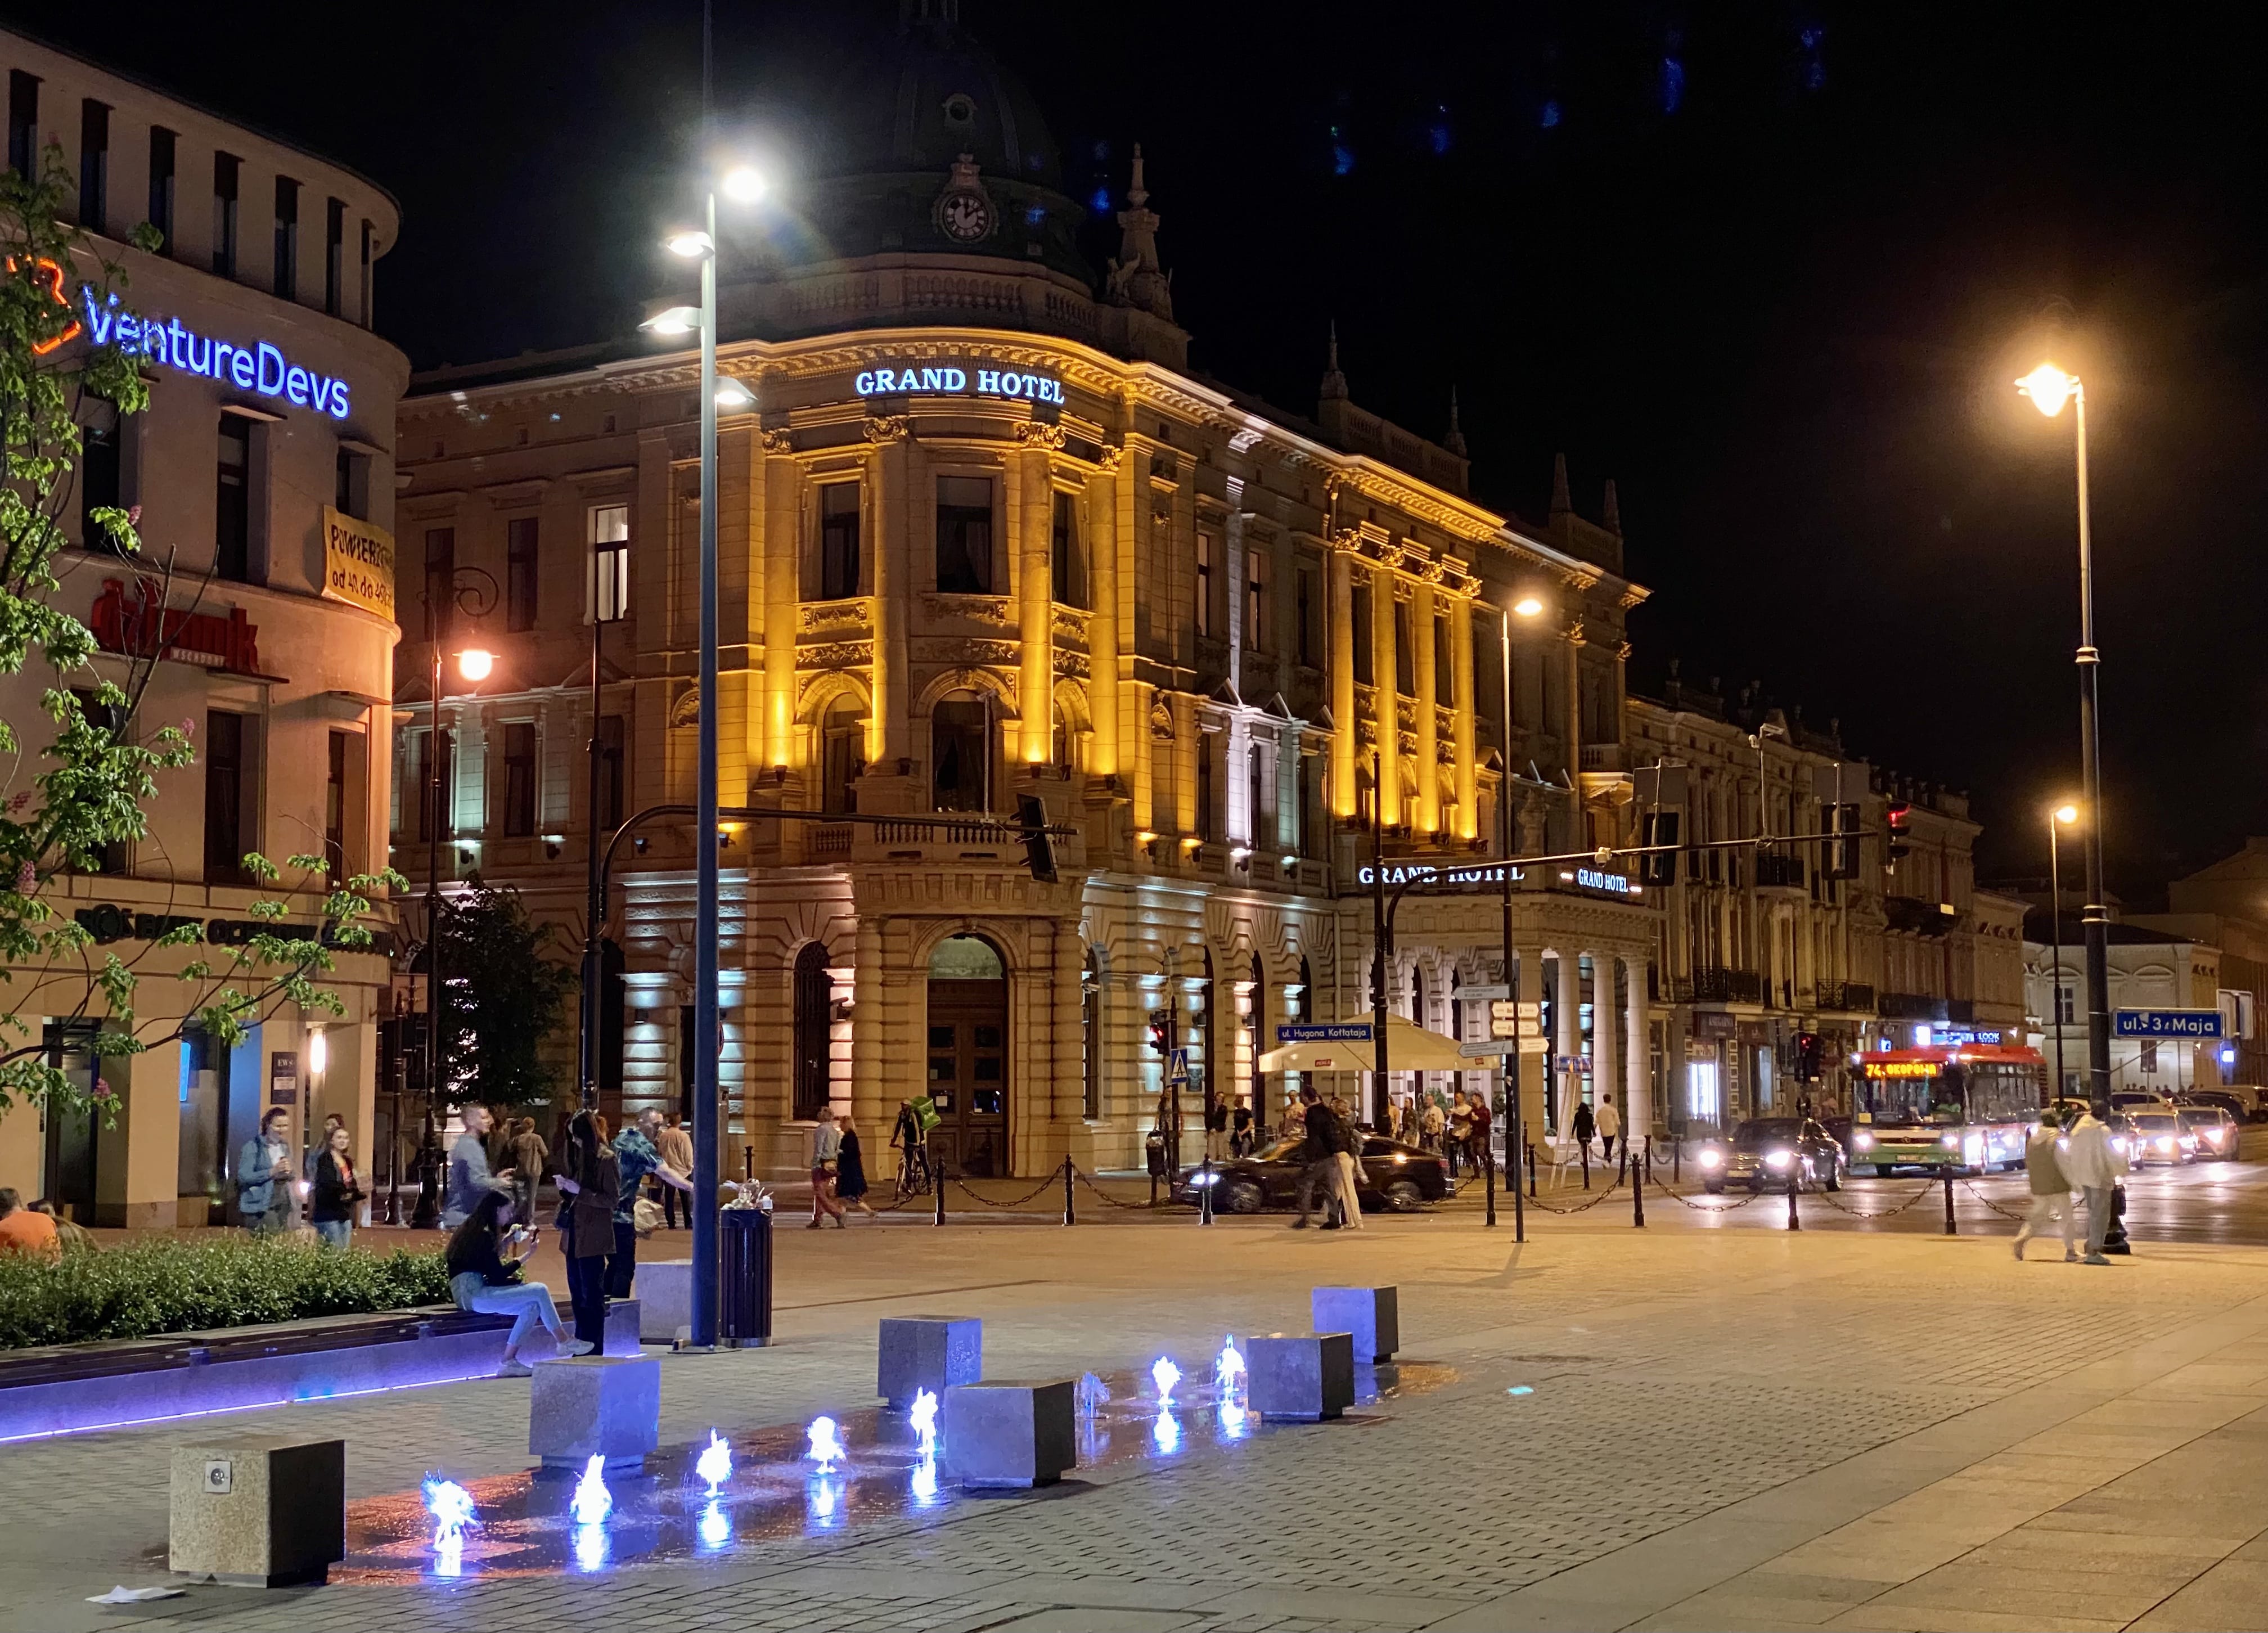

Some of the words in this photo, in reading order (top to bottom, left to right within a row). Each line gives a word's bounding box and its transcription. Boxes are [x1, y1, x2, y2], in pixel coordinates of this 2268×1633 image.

[83, 285, 349, 419] VentureDevs
[856, 368, 966, 394] GRAND
[978, 370, 1065, 404] HOTEL
[332, 568, 345, 589] od
[1358, 866, 1438, 884] GRAND
[1578, 868, 1604, 889] GRAND
[1605, 874, 1628, 892] HOTEL
[1282, 1029, 1290, 1037] ul.
[1294, 1029, 1324, 1039] Hugona
[2123, 1017, 2141, 1031] ul.
[2153, 1017, 2162, 1031] 3
[2172, 1018, 2214, 1034] Maja
[1979, 1032, 2000, 1040] LOOK
[1866, 1064, 1882, 1078] 74
